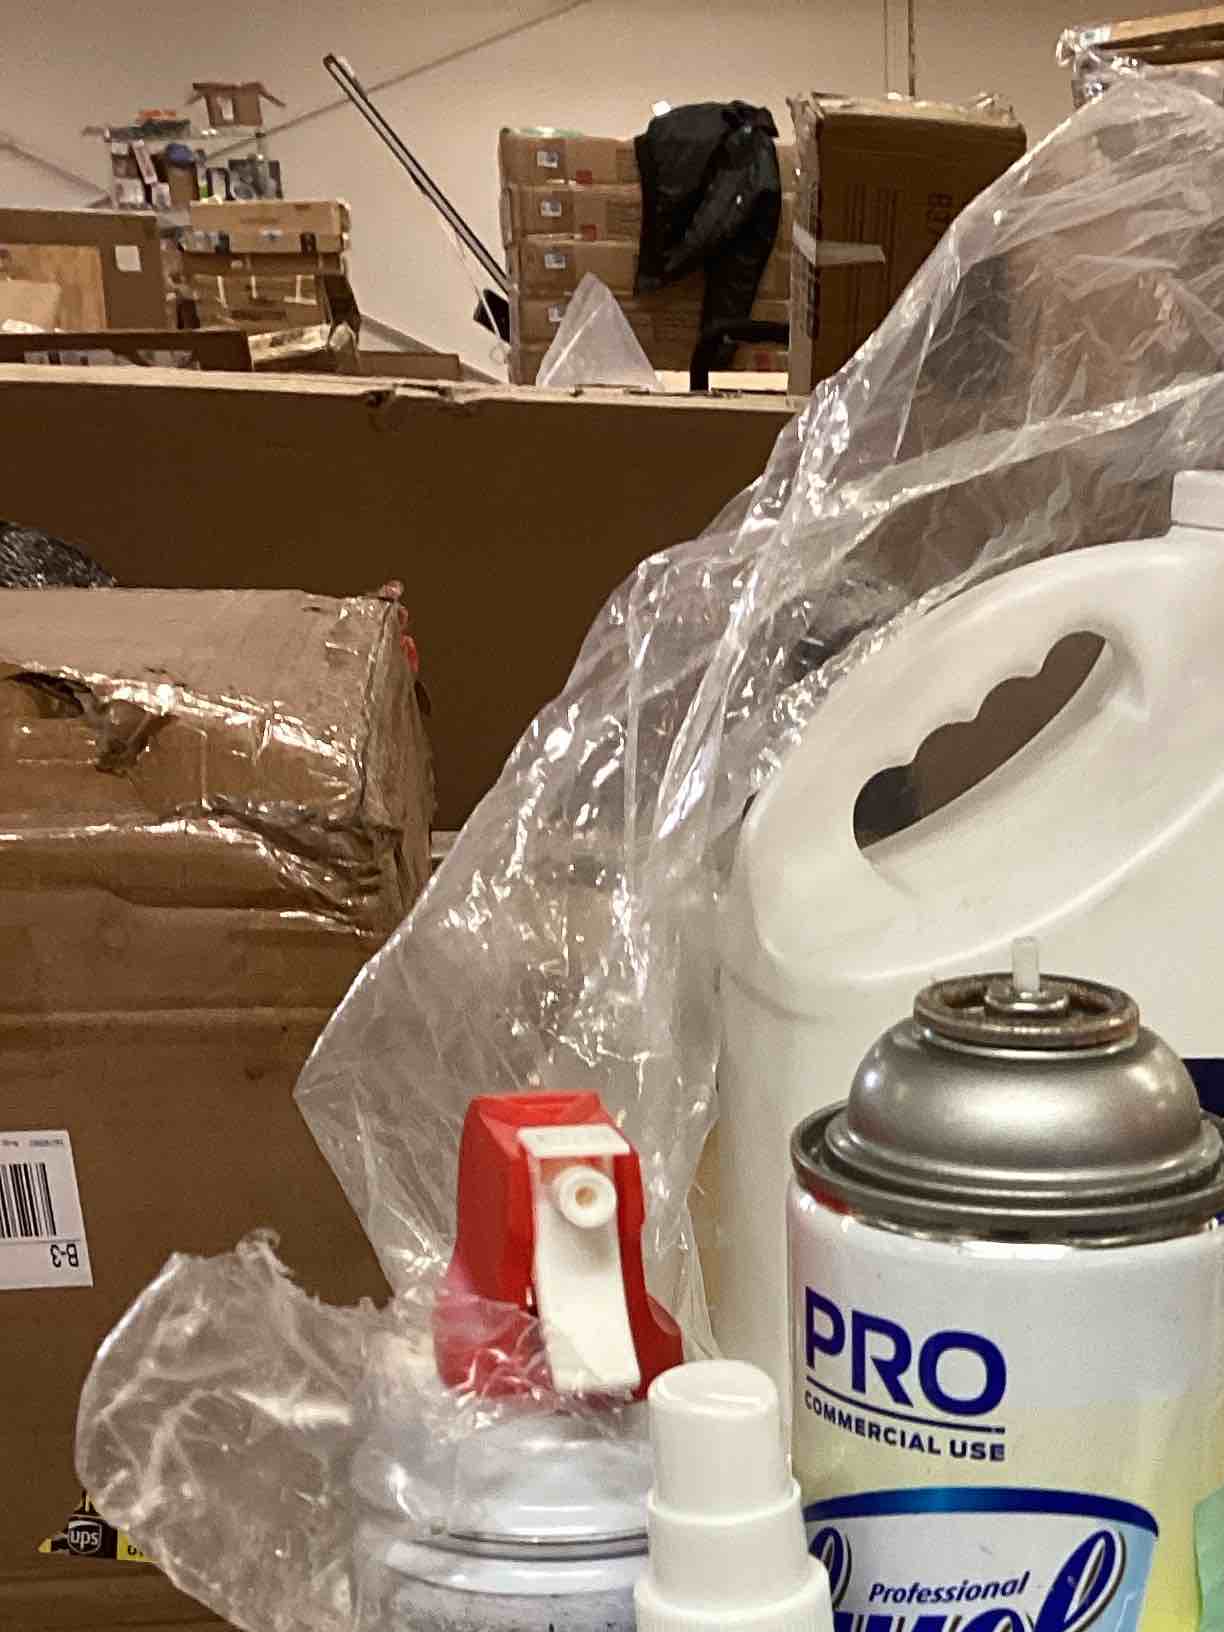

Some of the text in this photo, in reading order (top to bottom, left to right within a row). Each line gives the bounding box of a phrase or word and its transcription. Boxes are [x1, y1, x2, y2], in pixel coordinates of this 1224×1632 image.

[50, 1243, 79, 1268] B-3
[804, 1286, 1008, 1417] PRO
[803, 1389, 1006, 1463] COMMERCIAL USE
[69, 1530, 99, 1551] ups
[868, 1570, 1031, 1606] Professional
